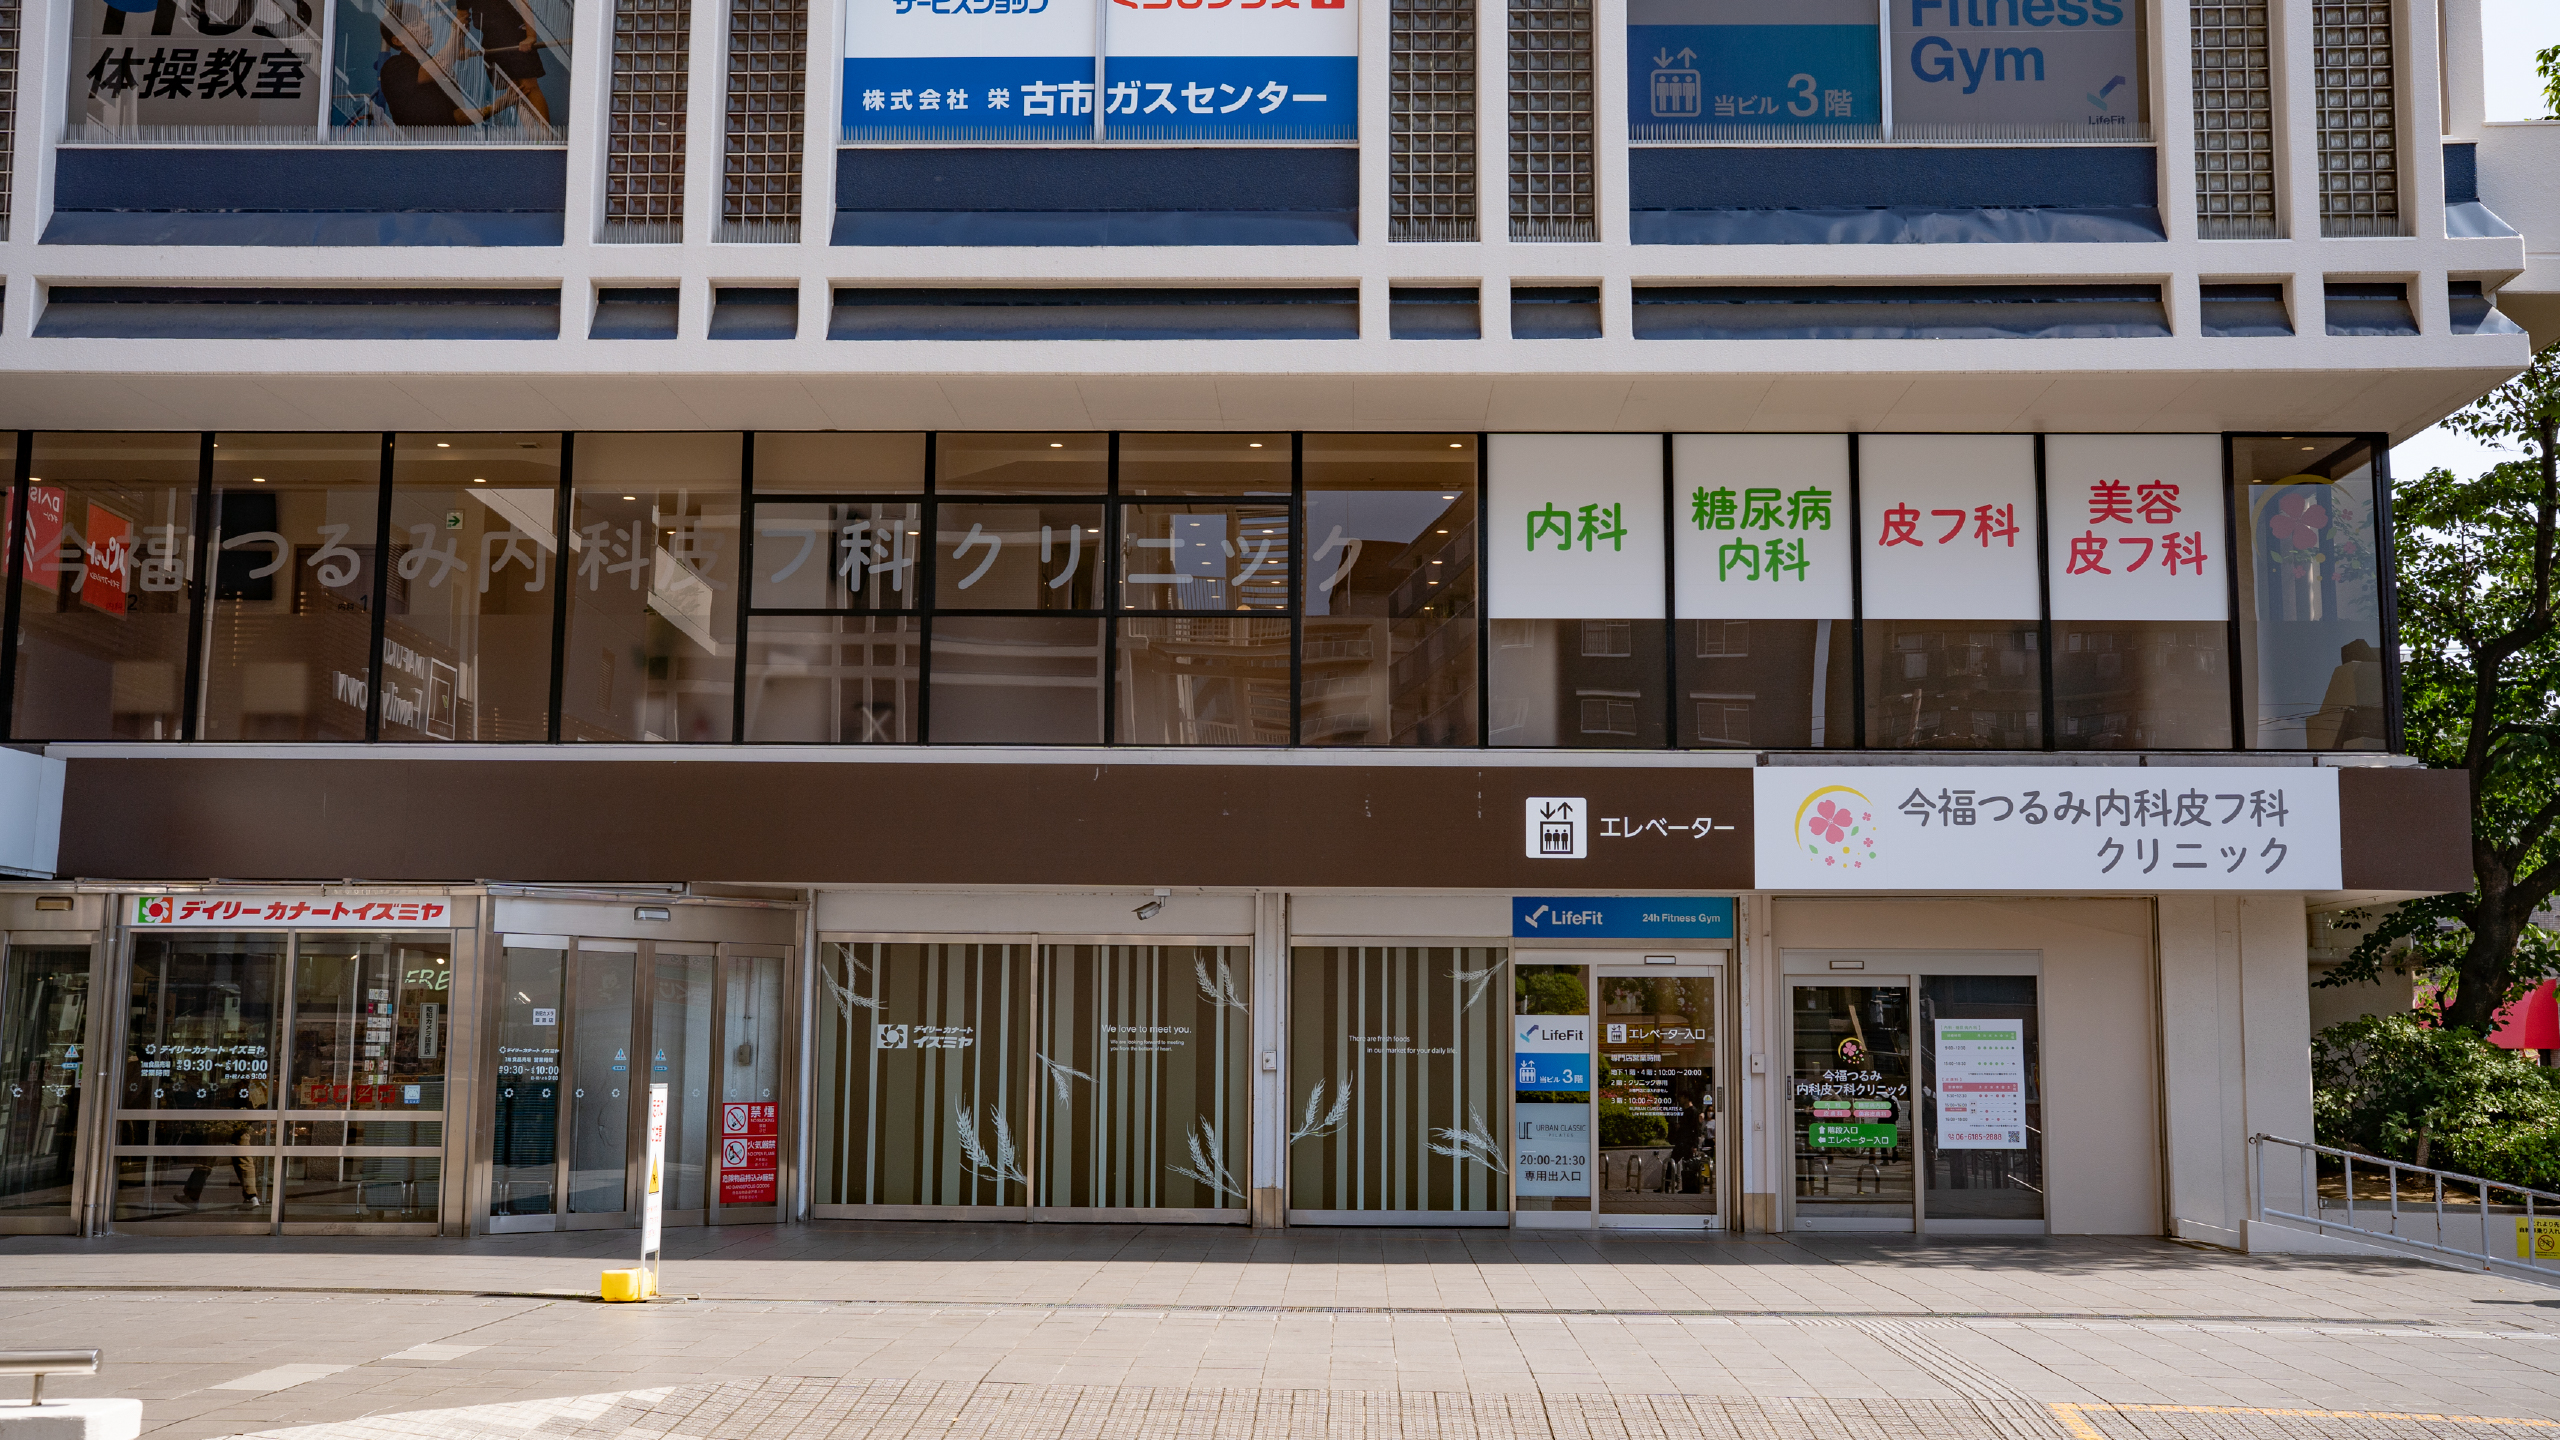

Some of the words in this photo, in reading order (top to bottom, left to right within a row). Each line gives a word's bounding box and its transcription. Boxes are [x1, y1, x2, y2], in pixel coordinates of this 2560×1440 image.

[1911, 0, 2124, 27] Fitness
[86, 47, 306, 99] 体操教室
[1911, 36, 2045, 95] Gym
[862, 88, 969, 111] 株式会社
[988, 88, 1010, 110] 栄
[1691, 486, 1833, 534] 糖尿病
[2088, 480, 2182, 525] 美容
[1526, 502, 1629, 554] 内科
[1878, 503, 2021, 548] 皮フ科
[1718, 537, 1812, 583] 内科
[2065, 531, 2209, 577] 皮フ科
[1897, 788, 2289, 829] 今福つるみ内科皮フ科
[1600, 816, 1735, 839] エレベーター
[2097, 837, 2289, 875] クリニック
[1551, 910, 1603, 926] LifeFit
[1642, 913, 1660, 923] 24h
[1661, 913, 1696, 923] Fitness
[1698, 913, 1721, 924] Gym
[1101, 1024, 1117, 1033] We
[1118, 1024, 1137, 1033] love
[1139, 1025, 1148, 1033] to
[1149, 1025, 1172, 1033] meet
[1173, 1026, 1192, 1035] you.
[1542, 1029, 1584, 1041] LifeFit
[1628, 1028, 1705, 1040] エレベーター入口
[913, 1036, 974, 1049] イズミヤ
[1822, 1069, 1883, 1082] 今福つるみ
[1796, 1083, 1907, 1096] 内科皮フ科クリニック
[1536, 1124, 1559, 1132] URBAN
[1560, 1124, 1586, 1132] CLASSIC
[1827, 1126, 1859, 1135] 階段入口
[747, 1140, 776, 1150] 火気厳禁
[1828, 1136, 1889, 1145] エレベーター入口
[1519, 1154, 1586, 1166] 20:00-21:30
[1524, 1170, 1582, 1182] 専用出入口
